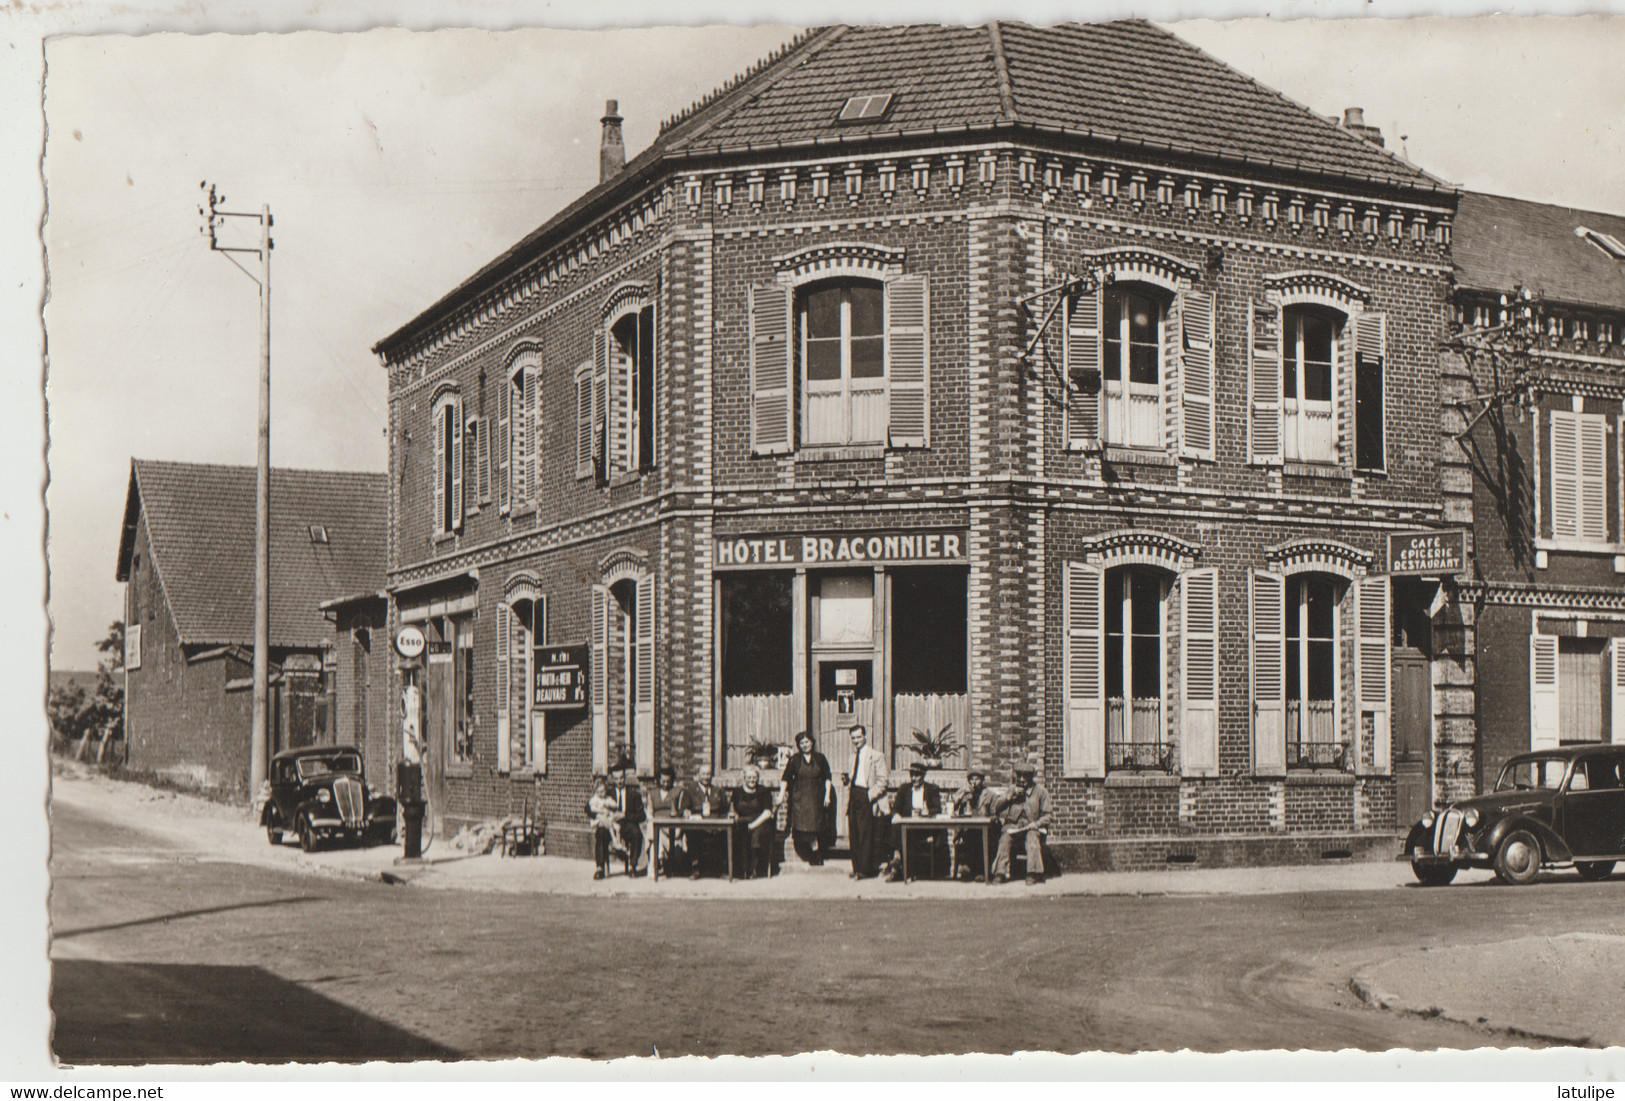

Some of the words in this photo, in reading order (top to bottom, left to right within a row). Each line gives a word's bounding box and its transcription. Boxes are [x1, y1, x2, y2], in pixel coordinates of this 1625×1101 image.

[718, 538, 795, 563] HÔTEL
[802, 534, 962, 563] BRACONNIER
[1410, 536, 1441, 549] CAFÉ
[1393, 558, 1460, 571] RESTAURANT
[400, 636, 422, 646] Esso
[536, 687, 567, 702] BEAUVAIS
